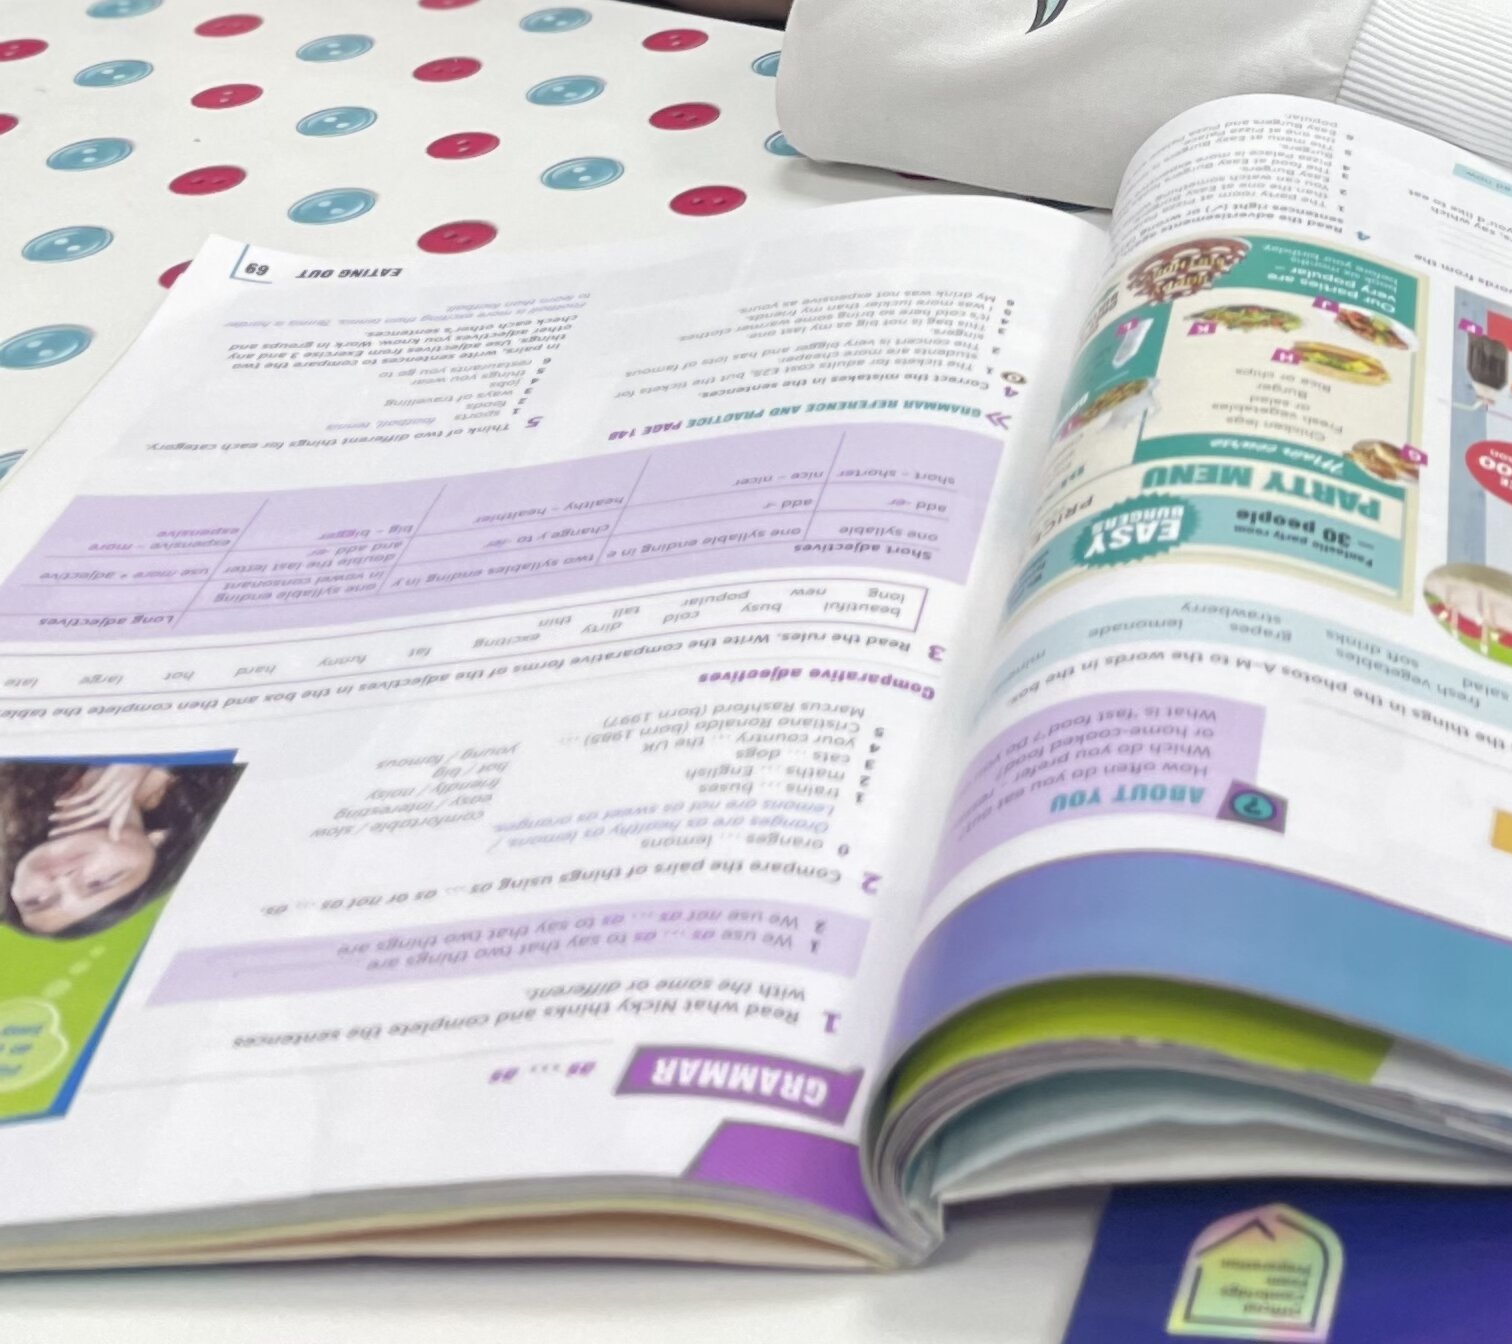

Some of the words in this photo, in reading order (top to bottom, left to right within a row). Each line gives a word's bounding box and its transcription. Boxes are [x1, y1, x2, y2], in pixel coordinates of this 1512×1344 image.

[245, 261, 270, 277] 69
[295, 268, 334, 280] OUT
[339, 267, 402, 278] EATING
[769, 403, 801, 417] AND
[805, 400, 899, 413] REFERENCE
[903, 400, 982, 418] GRAMMAR
[687, 408, 766, 428] PRACTICE
[641, 420, 683, 436] PAGE
[1210, 438, 1277, 455] course
[1283, 445, 1345, 476] Main
[1142, 464, 1253, 491] MENU
[1261, 470, 1381, 522] PARTY
[1092, 505, 1184, 533] BURGERS
[1235, 509, 1315, 536] people
[1083, 518, 1181, 559] EASY
[1234, 524, 1269, 538] room
[1273, 525, 1308, 544] party
[1322, 527, 1351, 546] 30
[1312, 537, 1373, 568] Fantastic
[1181, 602, 1282, 625] strawberry
[1088, 618, 1183, 639] lemonade
[1229, 622, 1292, 642] grapes
[1325, 629, 1381, 659] drinks
[1081, 659, 1099, 673] in
[1105, 651, 1164, 667] words
[1172, 652, 1203, 664] the
[1210, 654, 1229, 665] to
[1388, 650, 1419, 670] soft
[697, 666, 803, 686] adjectives
[1045, 664, 1075, 682] the
[1335, 648, 1431, 689] vegetables
[809, 669, 935, 700] Comparative
[1281, 665, 1348, 695] photos
[1462, 677, 1509, 702] salad
[1353, 688, 1383, 709] the
[1436, 684, 1480, 709] fresh
[1164, 707, 1217, 722] What
[1389, 701, 1405, 717] in
[1412, 707, 1469, 739] things
[1050, 725, 1188, 752] home-cooked
[1475, 732, 1505, 751] the
[1075, 744, 1111, 764] you
[1117, 744, 1143, 759] do
[1150, 743, 1211, 758] Which
[1013, 752, 1069, 783] prefer
[1071, 766, 1097, 782] do
[1104, 762, 1156, 778] often
[1162, 762, 1208, 778] How
[1030, 770, 1065, 791] you
[1049, 788, 1102, 813] YOU
[1112, 784, 1206, 805] ABOUT
[559, 862, 622, 884] things
[624, 865, 648, 881] of
[655, 858, 704, 877] pairs
[711, 861, 744, 877] the
[750, 861, 841, 883] Compare
[500, 875, 552, 892] using
[526, 980, 621, 1002] different.
[655, 979, 713, 994] same
[720, 980, 752, 997] the
[759, 984, 805, 1001] with
[496, 1008, 536, 1025] and
[544, 1003, 611, 1023] thinks
[618, 997, 677, 1018] Nicky
[684, 1000, 739, 1017] what
[746, 1004, 799, 1025] Read
[347, 1026, 382, 1041] the
[387, 1012, 489, 1037] complete
[232, 1028, 341, 1049] sentences
[488, 1067, 519, 1084] as
[568, 1061, 597, 1076] as
[651, 1057, 828, 1107] GRAMMAR
